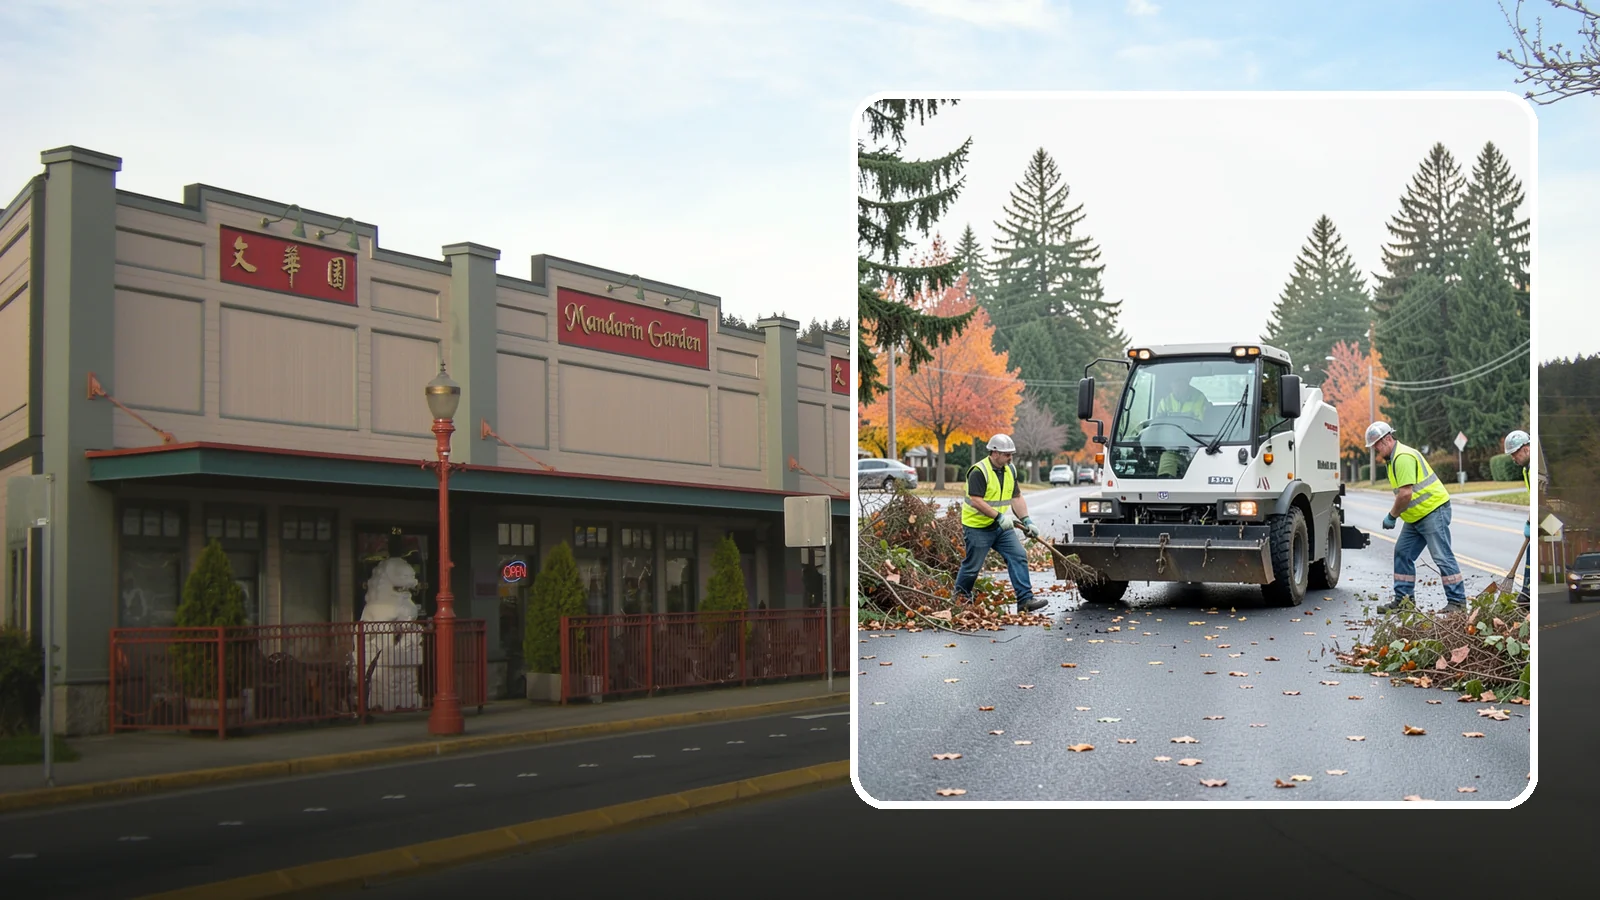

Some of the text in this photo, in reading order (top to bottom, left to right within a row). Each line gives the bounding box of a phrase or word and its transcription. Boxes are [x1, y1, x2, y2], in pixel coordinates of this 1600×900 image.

[230, 235, 346, 291] 文華園
[564, 302, 702, 352] Mandarin Garden
[503, 565, 527, 578] OPEN
